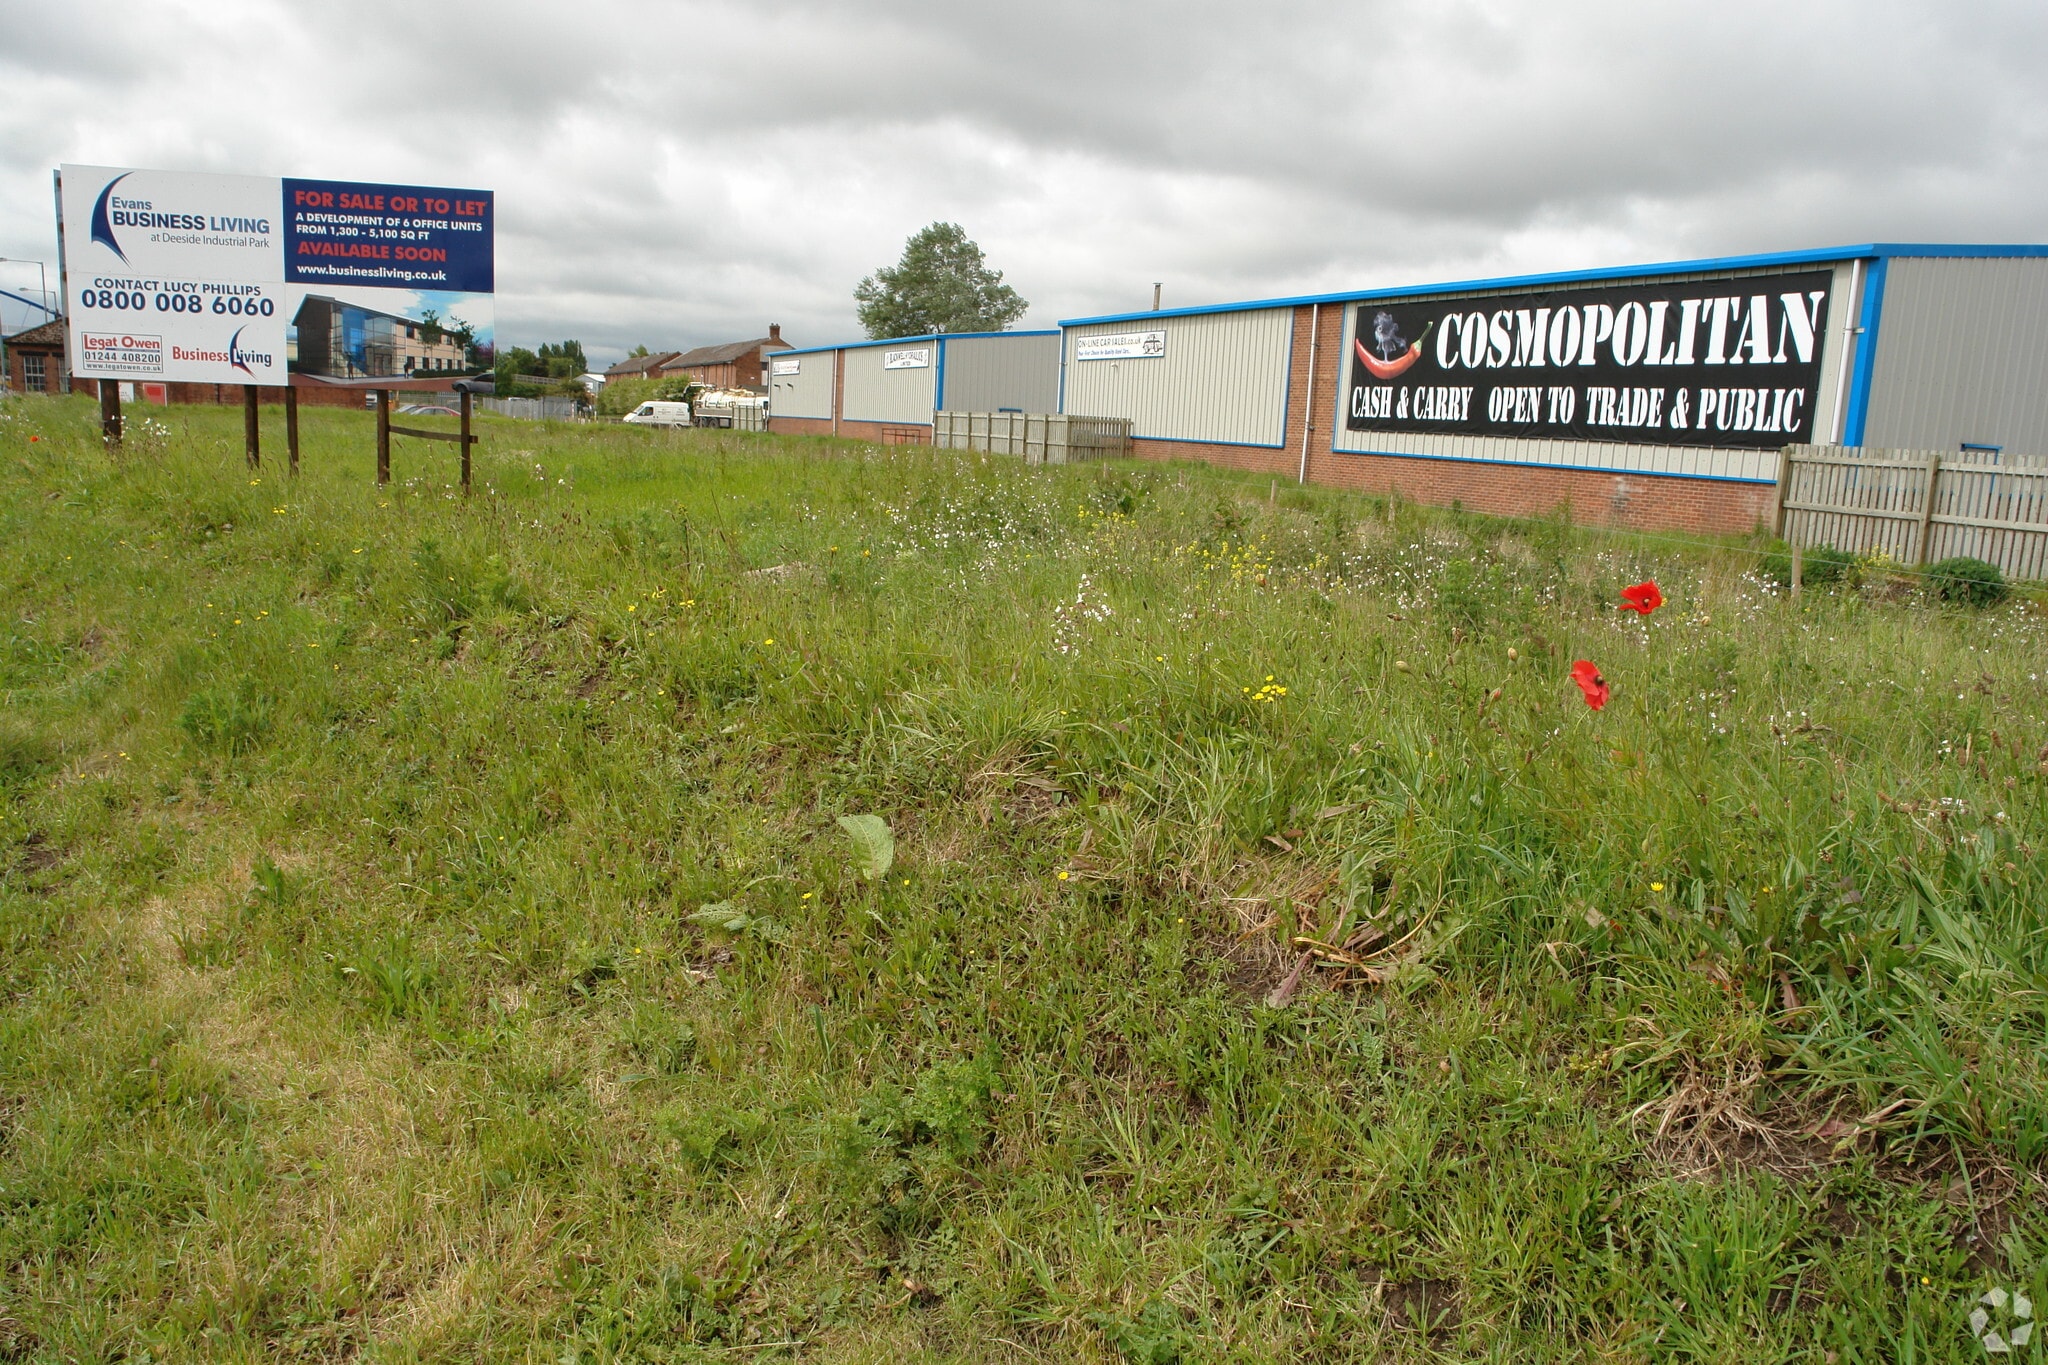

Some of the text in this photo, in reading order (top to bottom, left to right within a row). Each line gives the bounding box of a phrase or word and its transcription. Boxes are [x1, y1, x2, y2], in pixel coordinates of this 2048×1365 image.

[112, 197, 152, 210] Evans
[295, 191, 486, 216] FOR SALE OR TO LET
[113, 211, 270, 234] BUSINESS LIVING
[296, 213, 482, 231] A DEVELOPMENT OF 6 OFFICE UNITS
[151, 233, 270, 248] at Deeside Industrial Park
[296, 225, 326, 234] FROM
[330, 227, 358, 236] 1,300
[369, 229, 397, 238] 5,100
[401, 231, 415, 240] SQ
[418, 232, 429, 240] FT
[298, 241, 446, 262] AVAILABLE SOON
[297, 265, 446, 281] www.businessliving.co.uk
[94, 278, 261, 296] CONTACT LUCY PHILLIPS
[82, 289, 274, 316] 0800 008 6060
[1436, 291, 1825, 369] COSMOPOLITAN
[84, 334, 160, 350] Legat Owen
[85, 352, 160, 363] 01244 408200
[172, 346, 228, 362] Business
[87, 363, 161, 372] www.legatowen.co.uk
[1352, 386, 1804, 433] CASH & CARRY OPEN TO TRADE & PUBLIC
